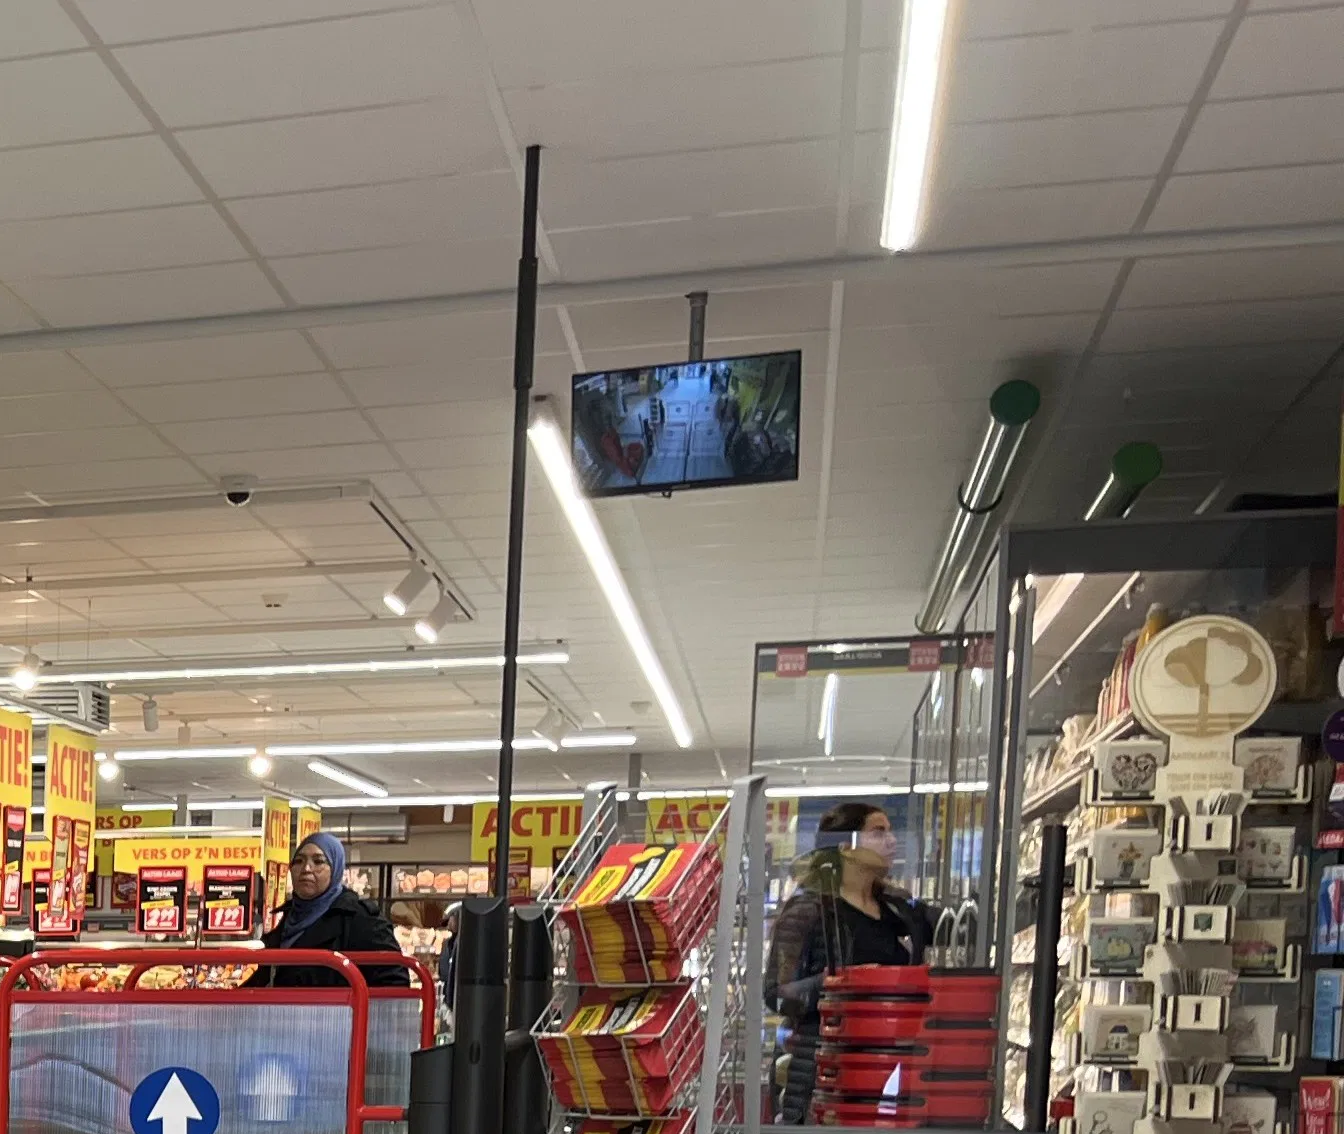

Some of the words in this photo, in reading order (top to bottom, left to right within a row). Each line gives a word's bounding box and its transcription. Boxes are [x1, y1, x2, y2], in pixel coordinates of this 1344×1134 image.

[50, 742, 93, 804] ACTIE!
[119, 815, 142, 829] OP
[132, 847, 167, 860] VERS
[171, 847, 191, 860] OP
[223, 846, 261, 859] BEST!
